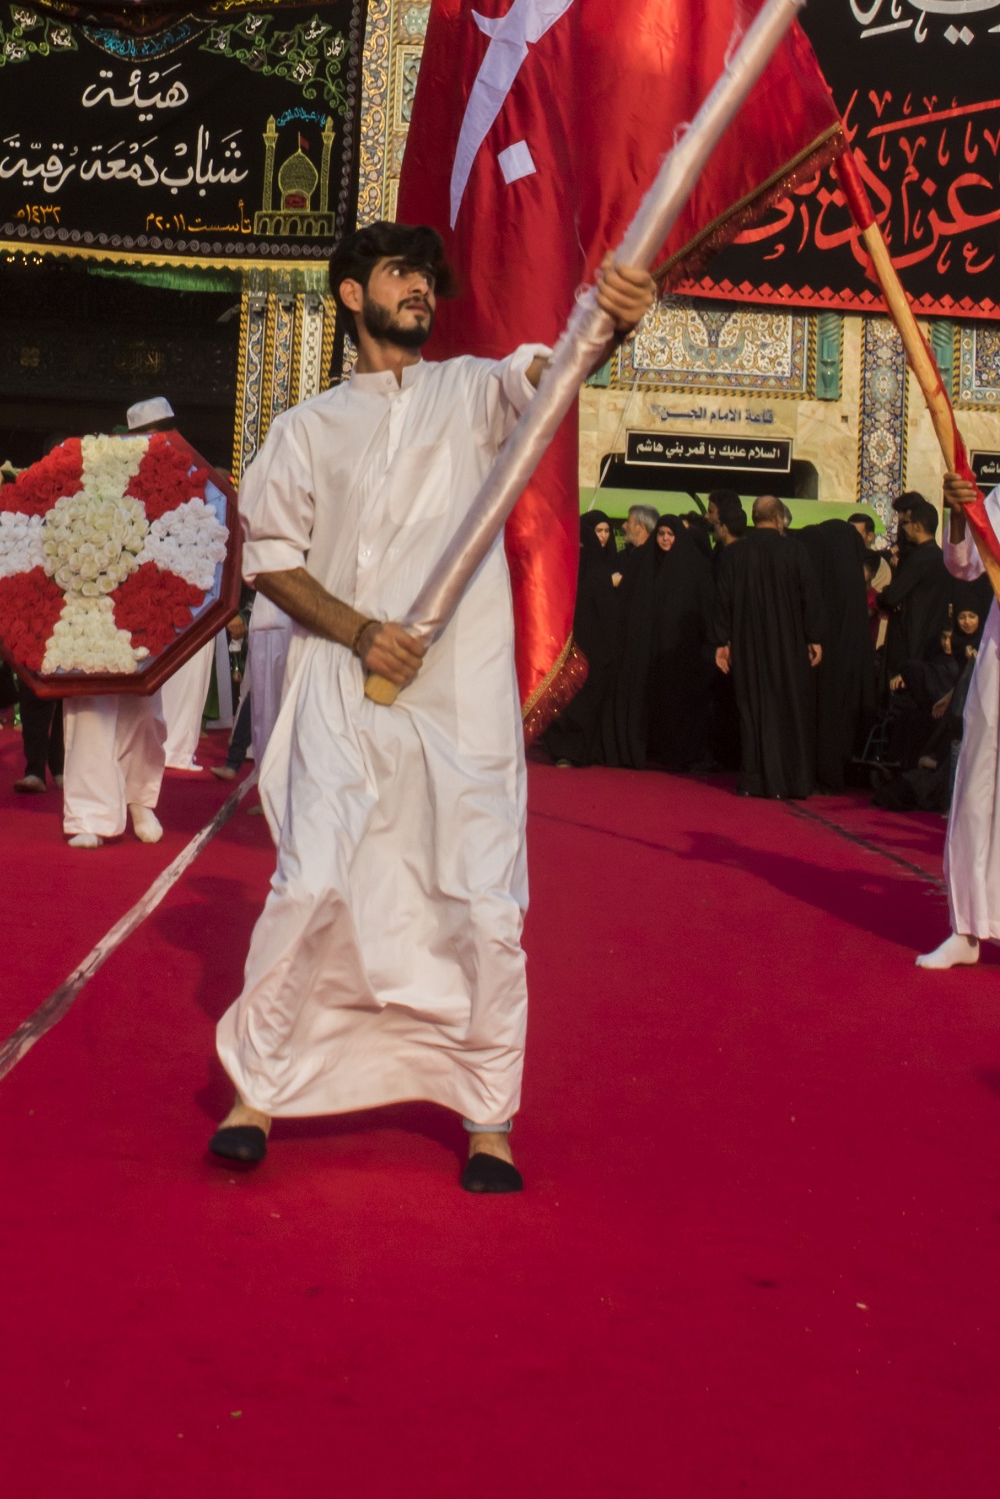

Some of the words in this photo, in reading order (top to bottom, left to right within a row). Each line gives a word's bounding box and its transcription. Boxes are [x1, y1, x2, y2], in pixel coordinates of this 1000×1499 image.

[745, 408, 774, 424] قاعة
[636, 438, 664, 455] هاشم
[665, 441, 684, 459] بني
[686, 441, 705, 457] قمر
[708, 444, 717, 459] يا
[718, 445, 746, 460] عليك
[748, 446, 781, 460] السلام
